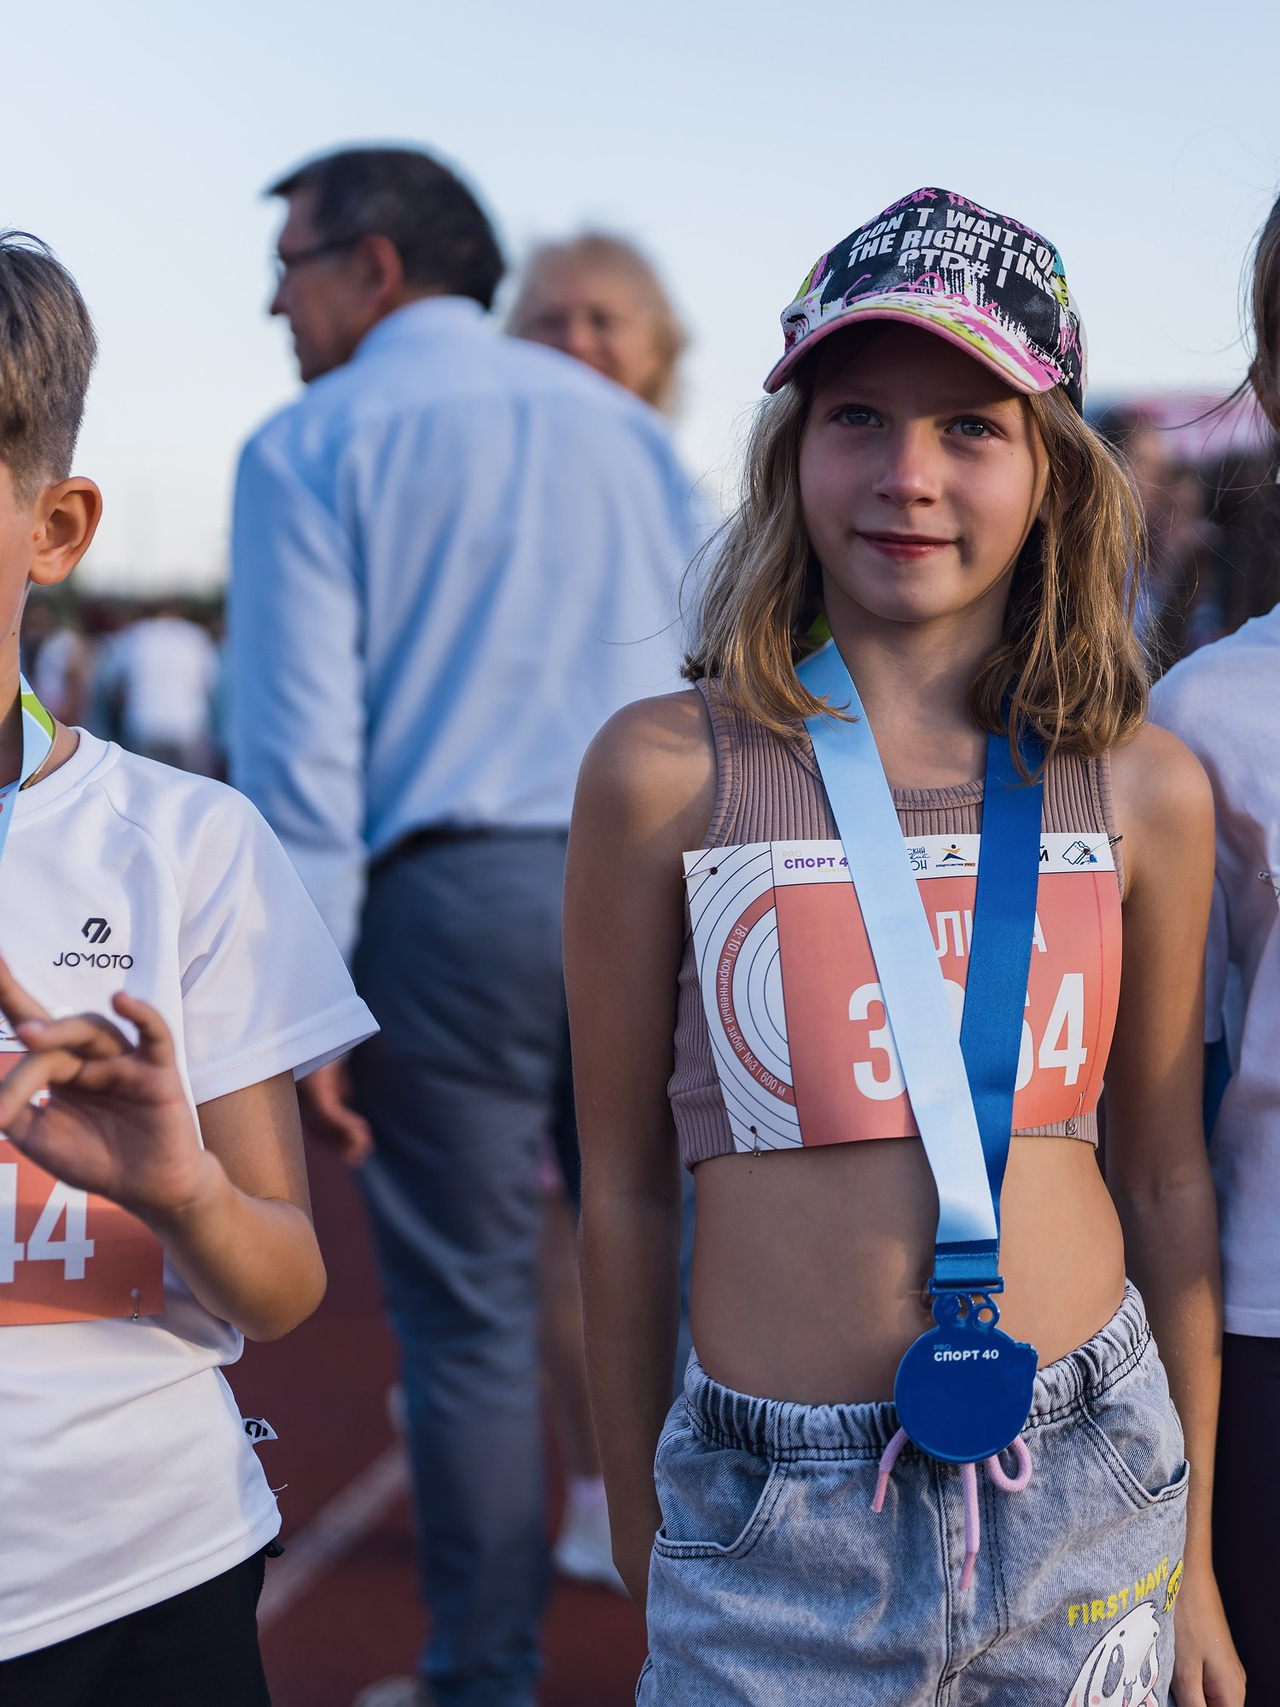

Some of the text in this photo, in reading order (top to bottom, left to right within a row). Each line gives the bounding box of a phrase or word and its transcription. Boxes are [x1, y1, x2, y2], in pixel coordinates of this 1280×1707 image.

[945, 209, 1018, 246] WAIT
[847, 233, 896, 268] THE
[901, 229, 995, 261] RIGHT
[728, 923, 749, 952] 18:10
[52, 952, 134, 970] JOMOTO
[718, 959, 735, 1024] коричневый
[727, 1026, 746, 1055] забег
[742, 1051, 758, 1072] №3
[760, 1071, 778, 1091] 600
[933, 1348, 999, 1362] СПОРТ 40
[1067, 1588, 1129, 1627] FIRST
[1134, 1557, 1169, 1603] HAVE
